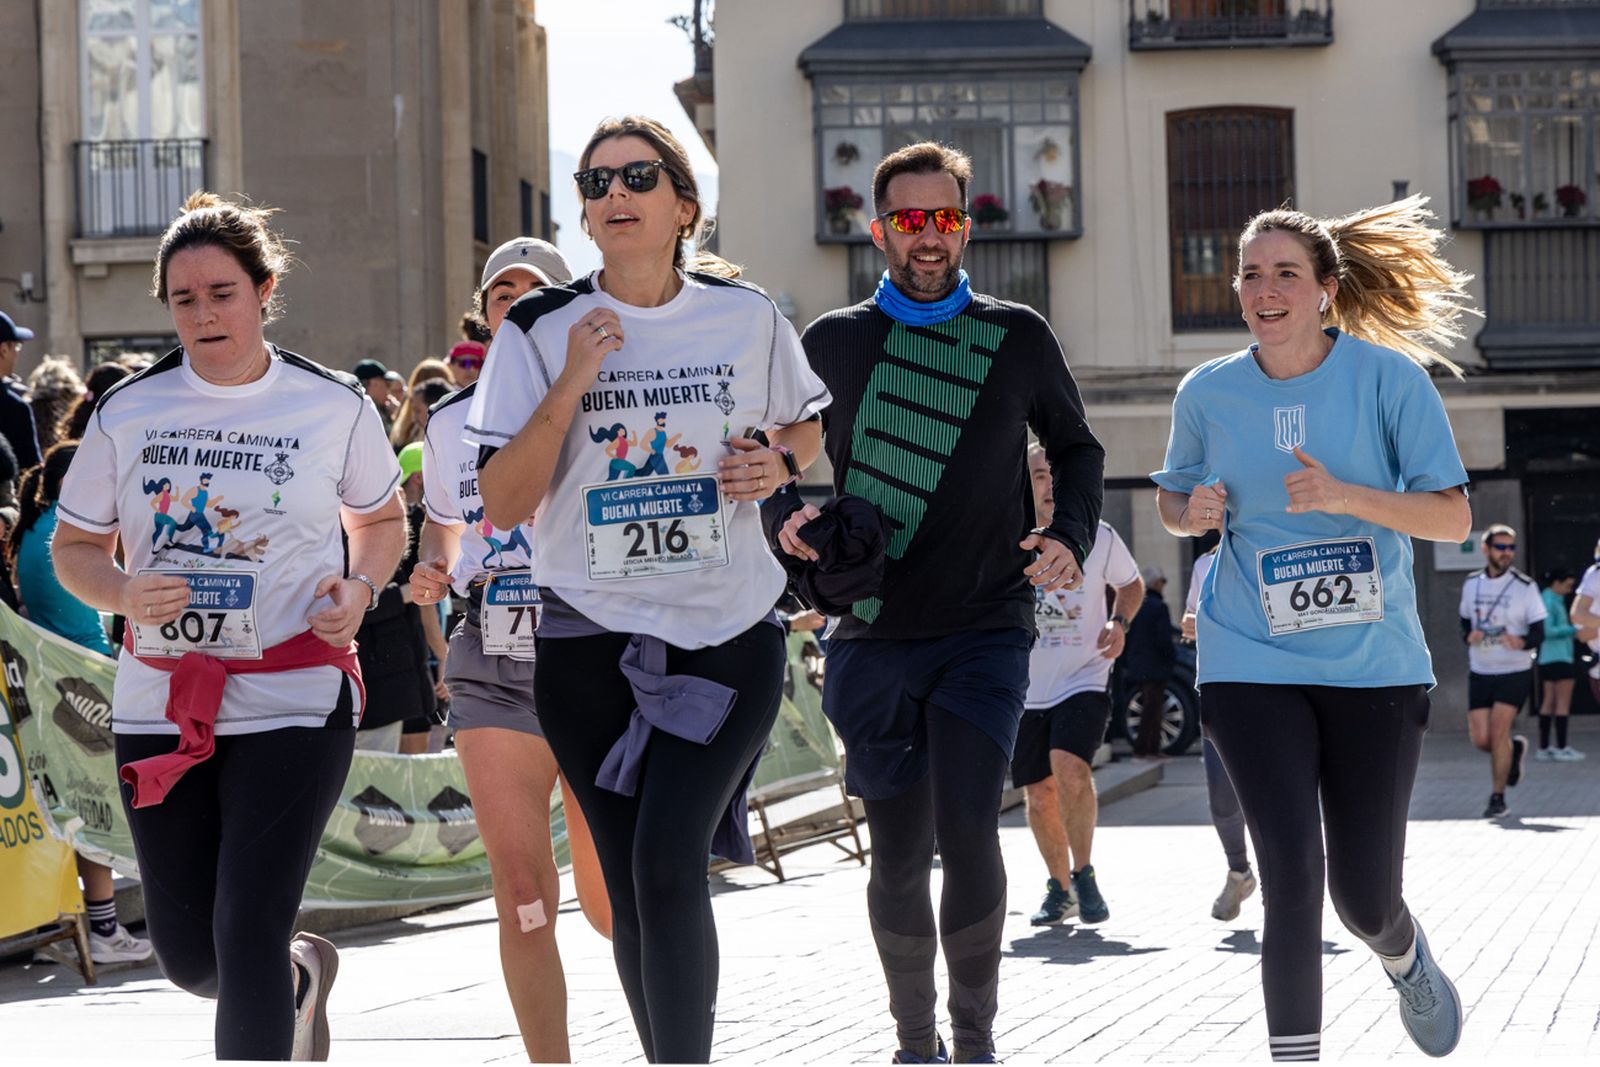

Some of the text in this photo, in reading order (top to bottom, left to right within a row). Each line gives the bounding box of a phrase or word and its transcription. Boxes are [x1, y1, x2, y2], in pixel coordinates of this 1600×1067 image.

[598, 364, 735, 382] CARRERA CAMINATA
[582, 384, 712, 412] BUENA MUERTE
[145, 428, 300, 450] VI CARRERA CAMINATA
[142, 445, 264, 472] BUENA MUERTE
[458, 462, 466, 474] VI
[460, 478, 481, 499] BUE
[600, 482, 703, 502] VI CARRERA CAMINATA
[602, 498, 684, 520] BUENA MUERTE
[622, 519, 689, 558] 216
[1272, 545, 1360, 564] VI CARRERA CAMINATA
[1274, 558, 1344, 580] BUENA MUERTE
[198, 578, 241, 588] CAMINATA
[506, 577, 532, 586] CARRER
[188, 591, 221, 605] UERTE
[496, 590, 520, 602] BUENA
[1290, 575, 1356, 612] 662
